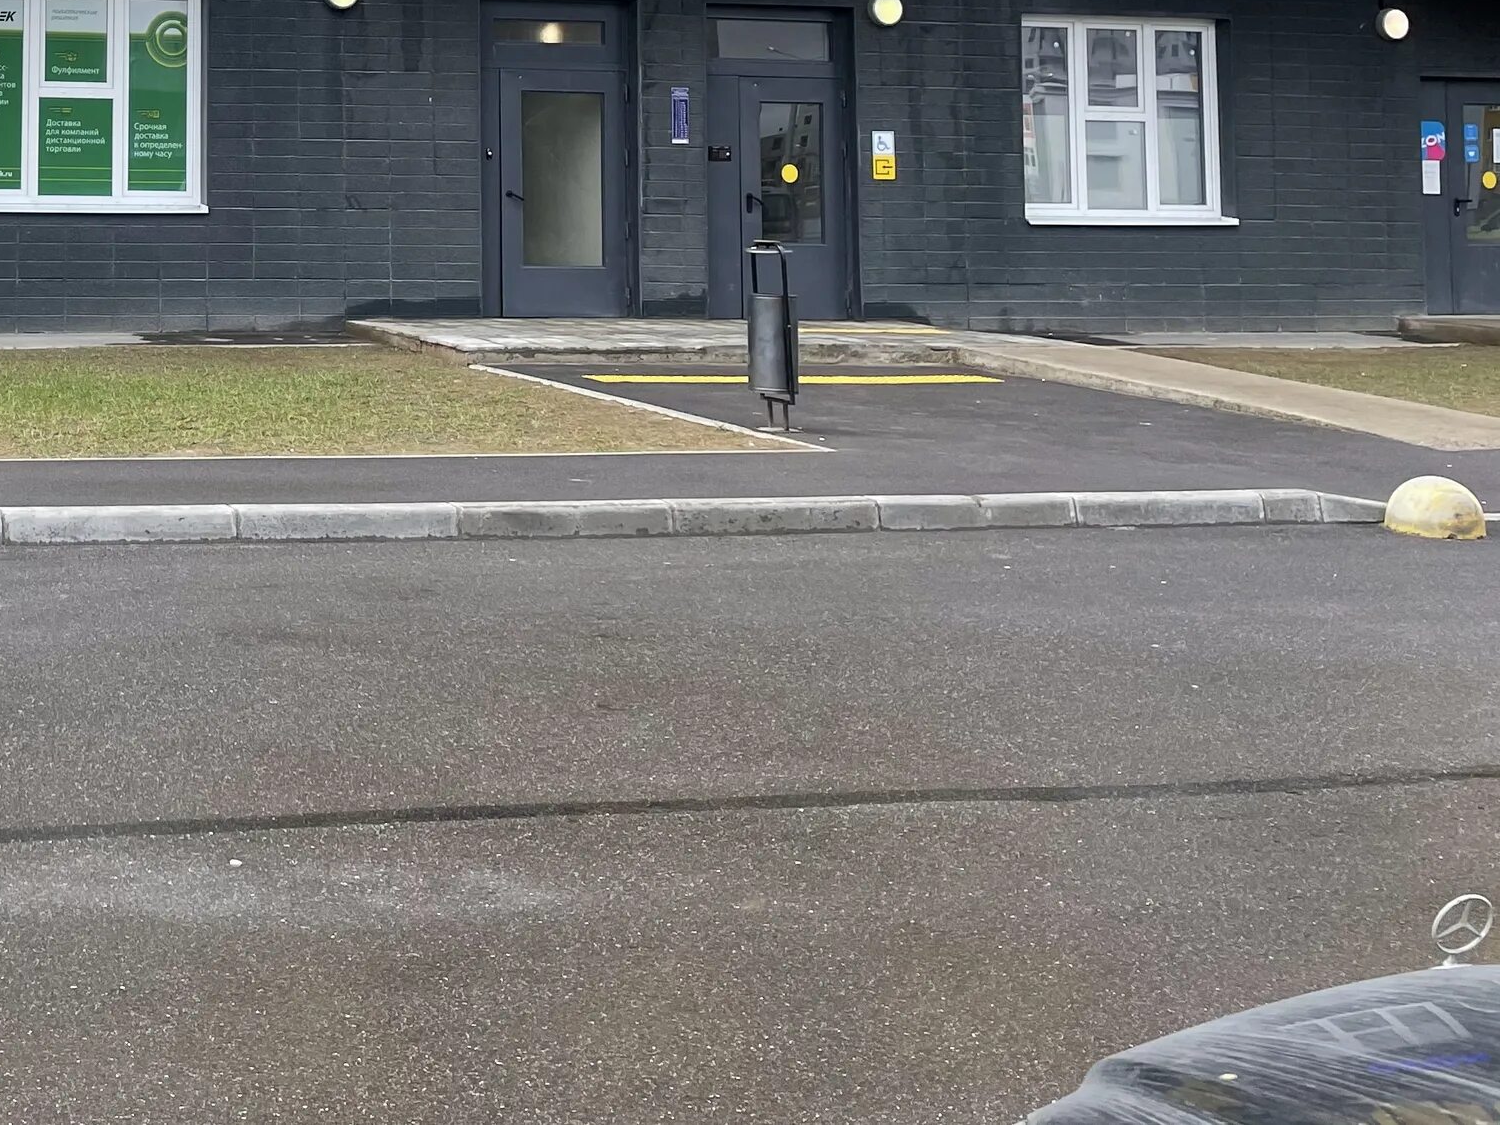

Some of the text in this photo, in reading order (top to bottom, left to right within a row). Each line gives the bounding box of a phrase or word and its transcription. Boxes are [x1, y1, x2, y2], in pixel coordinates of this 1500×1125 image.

[51, 65, 100, 75] Фулфилмент
[46, 118, 81, 127] Доставка
[134, 122, 167, 131] Срочная
[61, 128, 99, 136] компаний
[45, 137, 106, 145] дистанционной
[133, 151, 172, 159] ному часу
